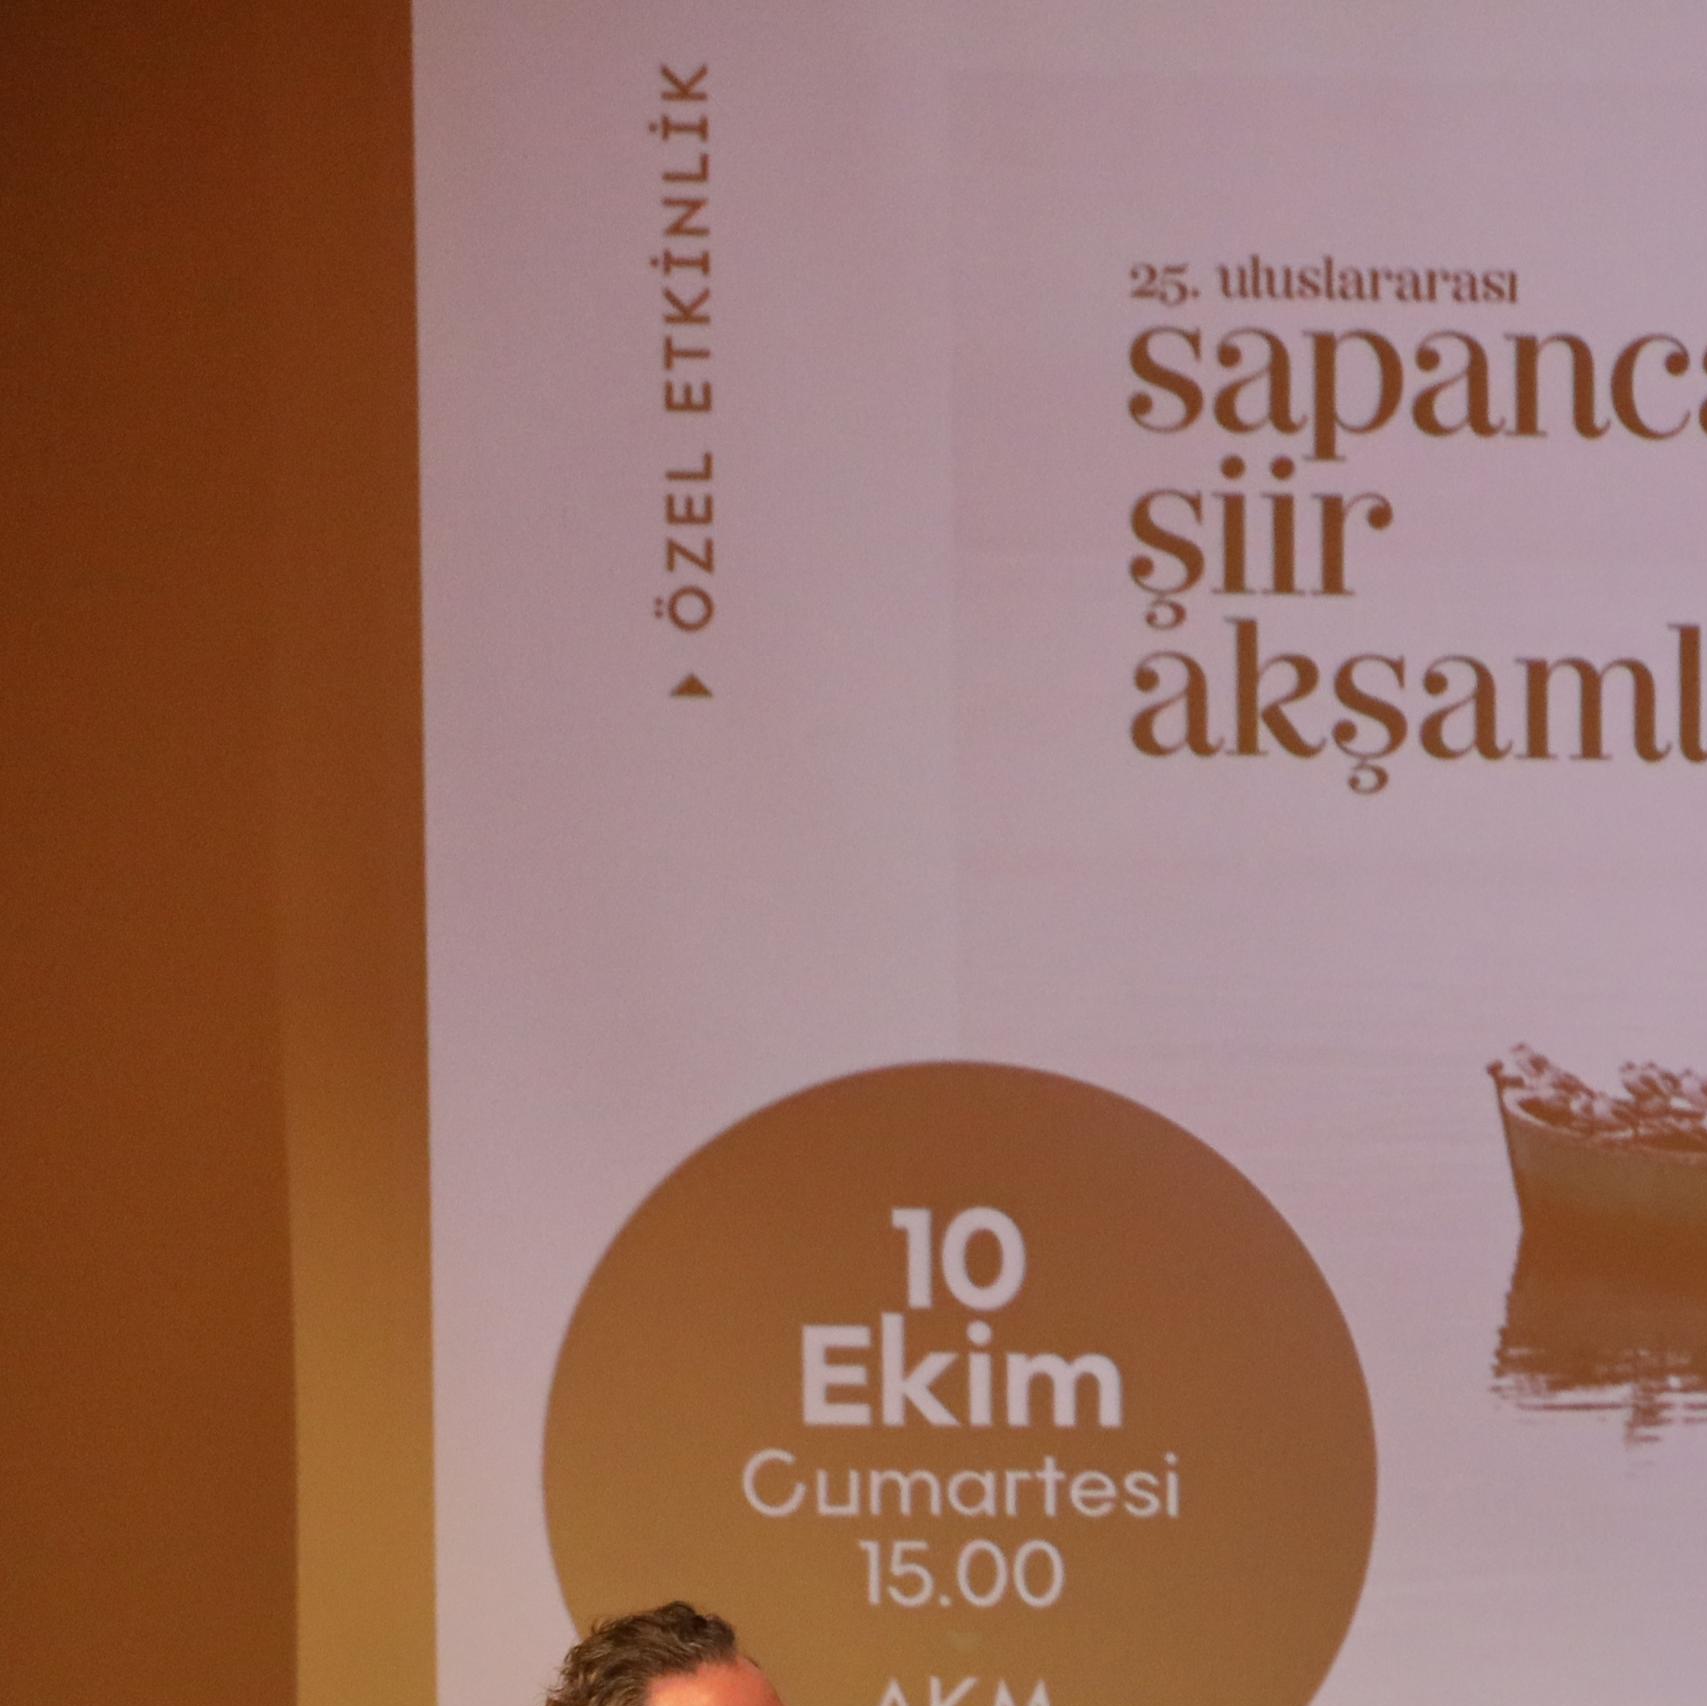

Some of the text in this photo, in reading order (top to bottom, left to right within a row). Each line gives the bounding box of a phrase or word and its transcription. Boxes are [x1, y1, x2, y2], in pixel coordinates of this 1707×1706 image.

[1129, 254, 1519, 306] 25. uluslararası
[648, 63, 715, 633] ÖZEL ETKİNLİK
[1128, 455, 1394, 631] şiir
[890, 1205, 1027, 1312] 10
[801, 1311, 1125, 1428] Ekim
[742, 1448, 1181, 1519] Cumartesi
[858, 1538, 1065, 1609] 15.00
